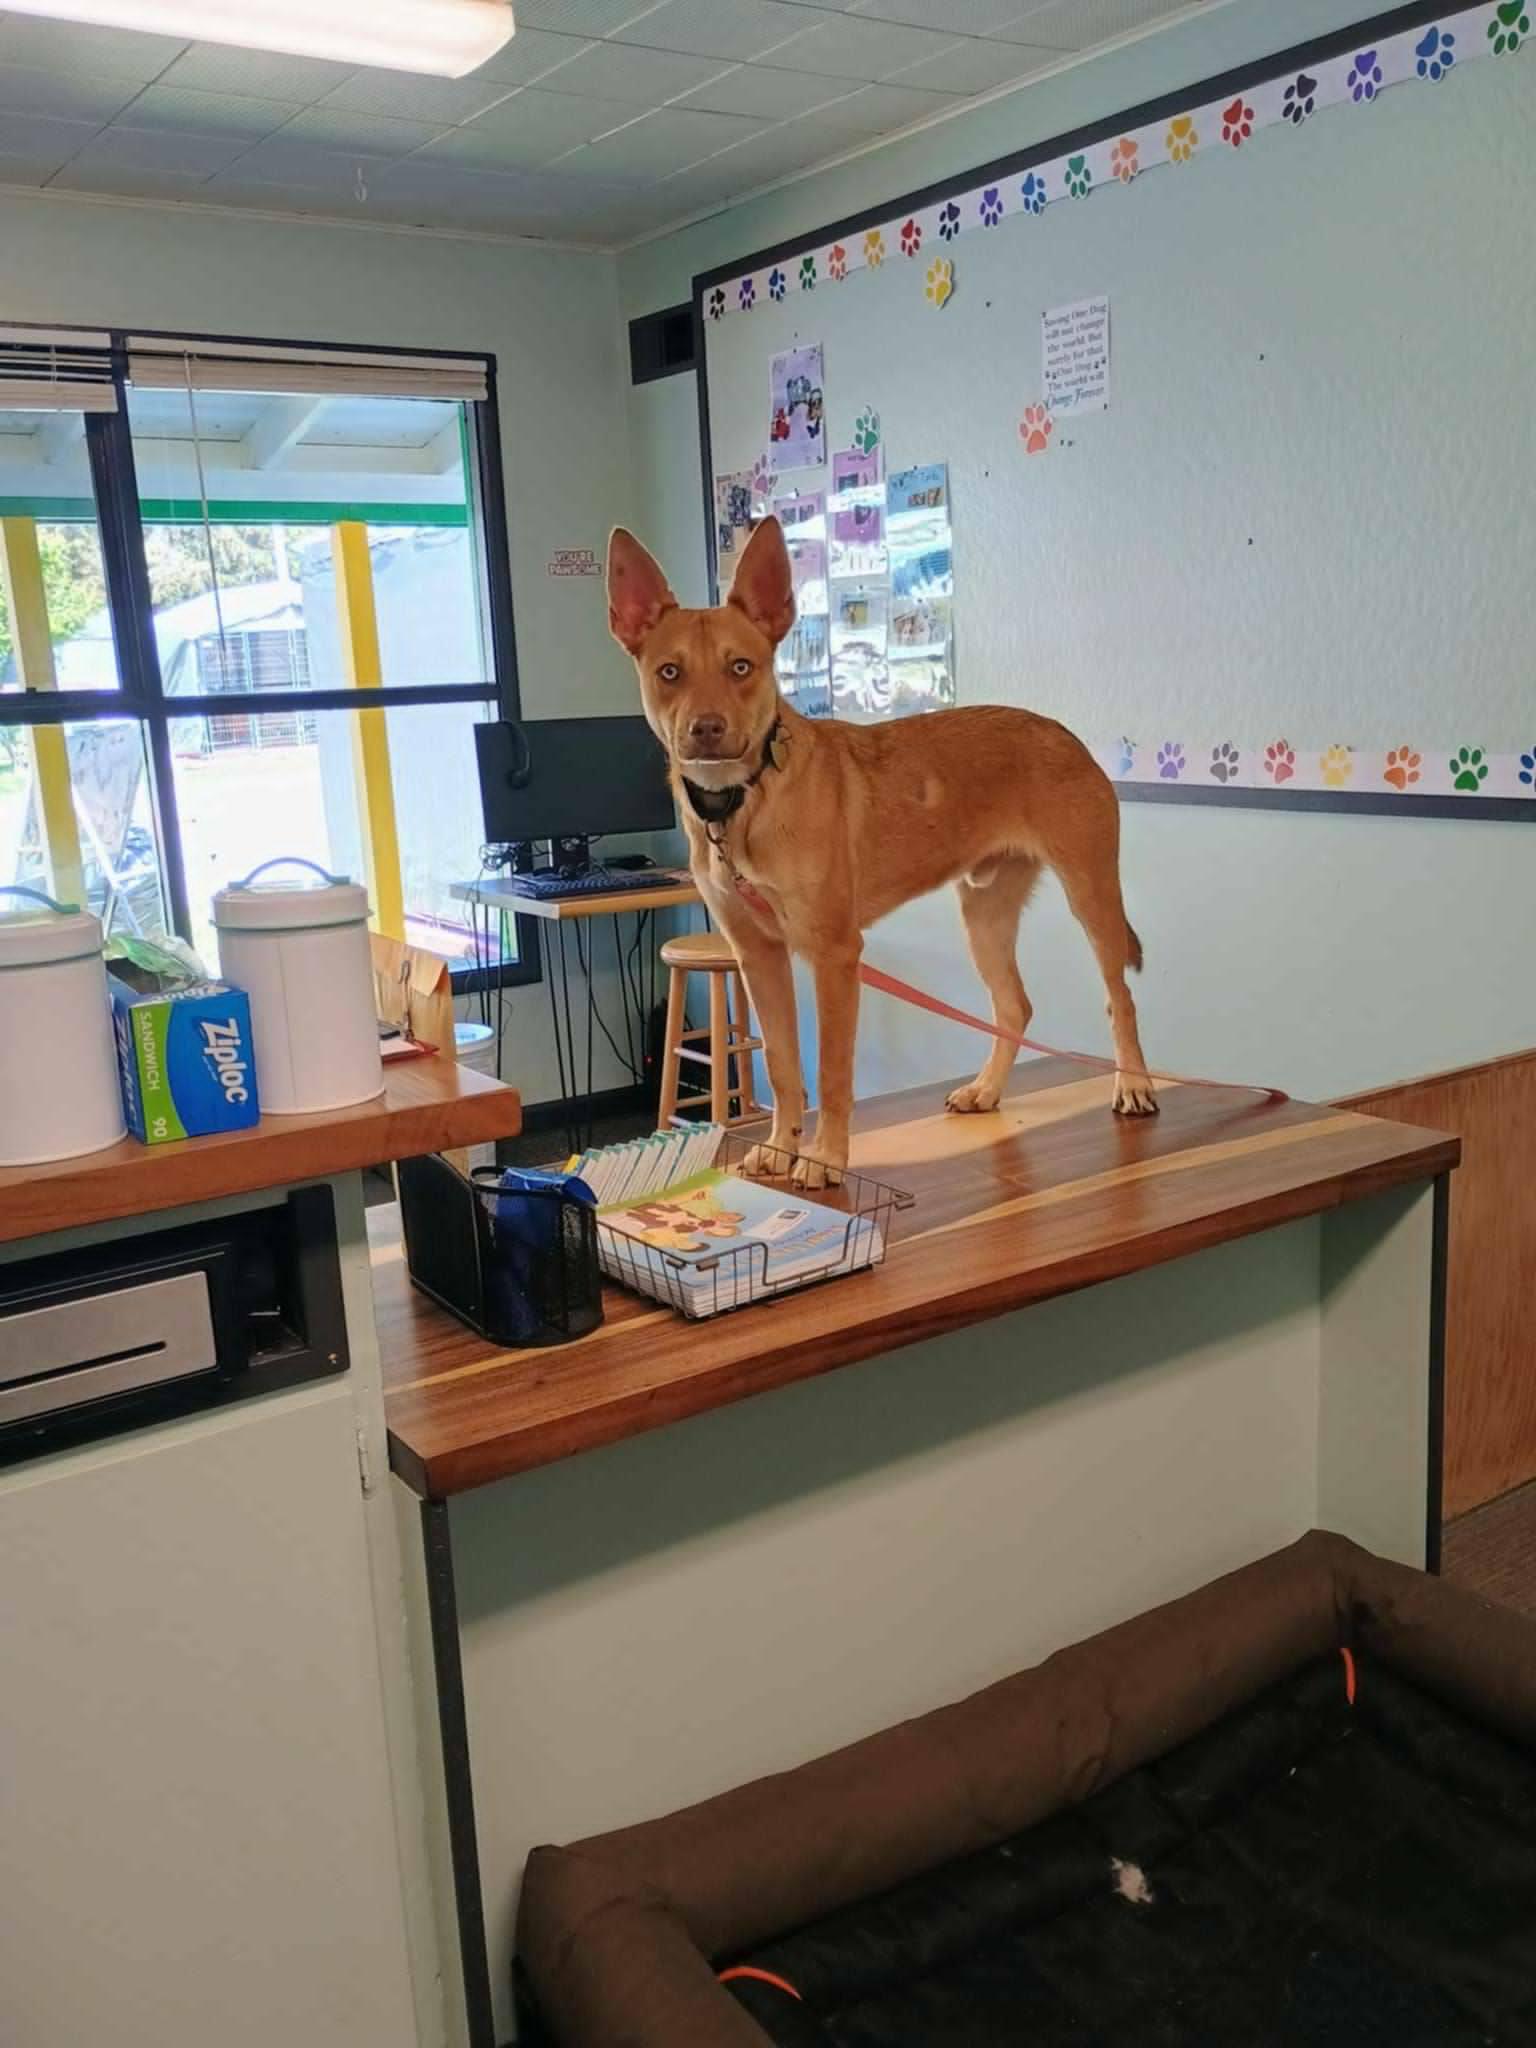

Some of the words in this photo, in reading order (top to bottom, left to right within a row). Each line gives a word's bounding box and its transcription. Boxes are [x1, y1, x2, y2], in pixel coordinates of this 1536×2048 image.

[1071, 310, 1088, 319] One
[1048, 381, 1062, 392] The
[140, 1011, 161, 1091] SANDWICH
[200, 1018, 248, 1104] Ziploc
[153, 1117, 168, 1137] 90
